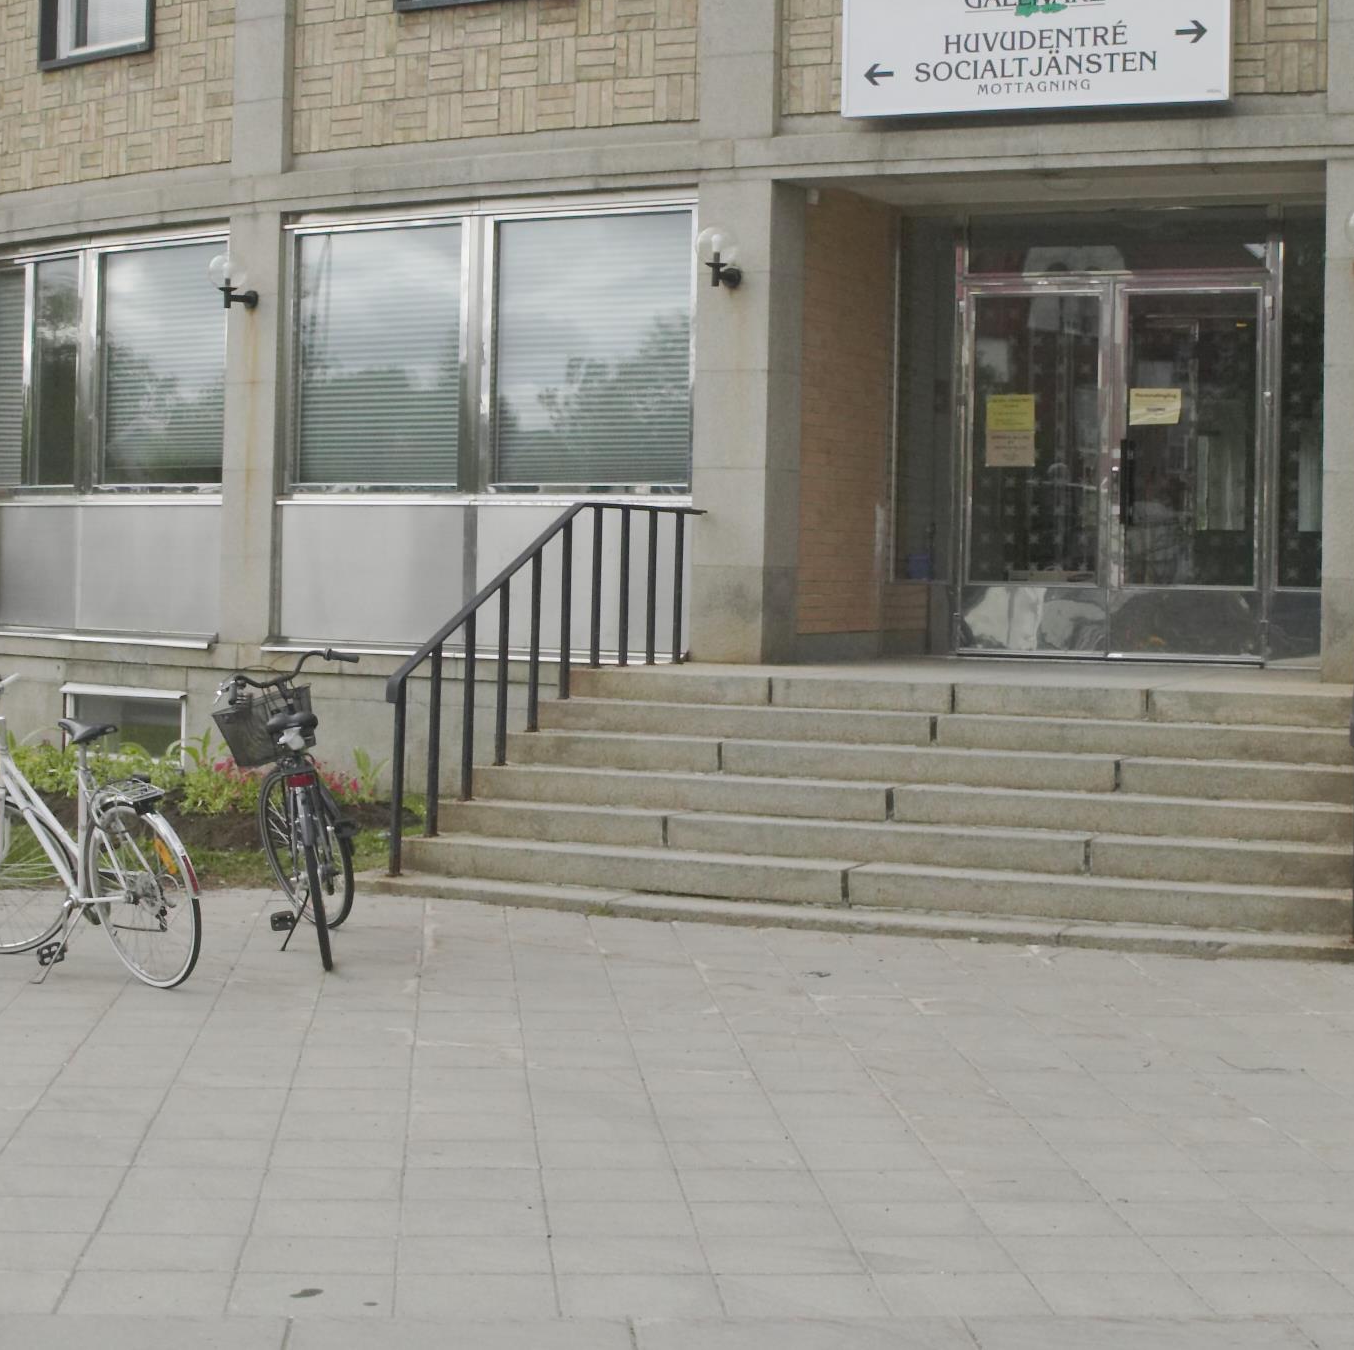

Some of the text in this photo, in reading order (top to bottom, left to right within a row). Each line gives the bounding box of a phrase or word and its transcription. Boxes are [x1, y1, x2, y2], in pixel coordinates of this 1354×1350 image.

[945, 20, 1128, 54] HUVUDENTRÉ
[915, 50, 1157, 82] SOCIALTJÄNSTEN
[977, 78, 1091, 95] MOTTAGNING
